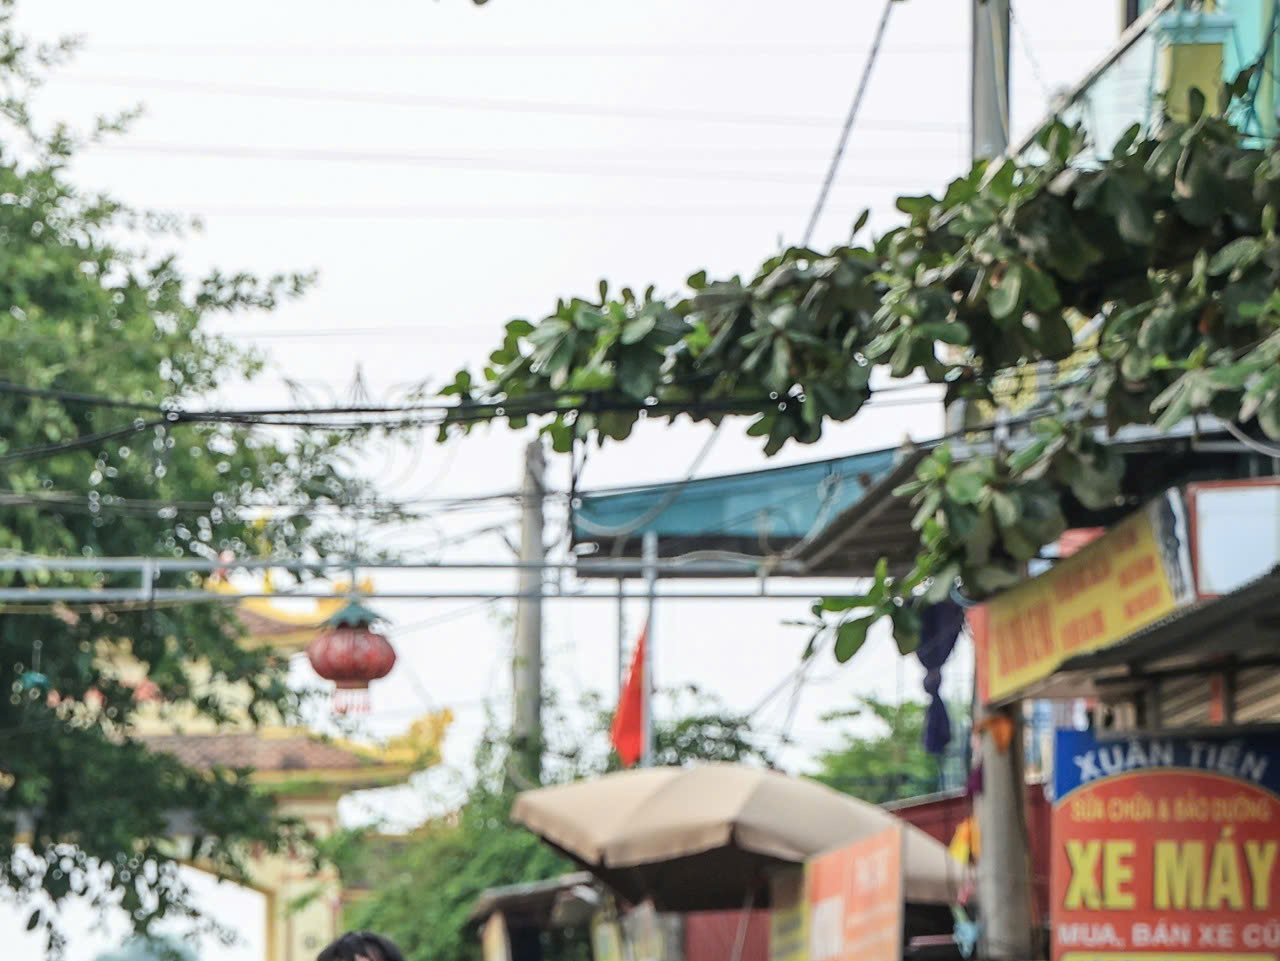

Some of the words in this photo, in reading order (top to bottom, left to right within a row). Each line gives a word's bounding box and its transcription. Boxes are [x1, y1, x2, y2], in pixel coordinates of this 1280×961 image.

[1064, 839, 1136, 911] XE
[1153, 826, 1278, 911] MÁY
[1131, 918, 1191, 946] BÁN
[1198, 923, 1233, 946] XE
